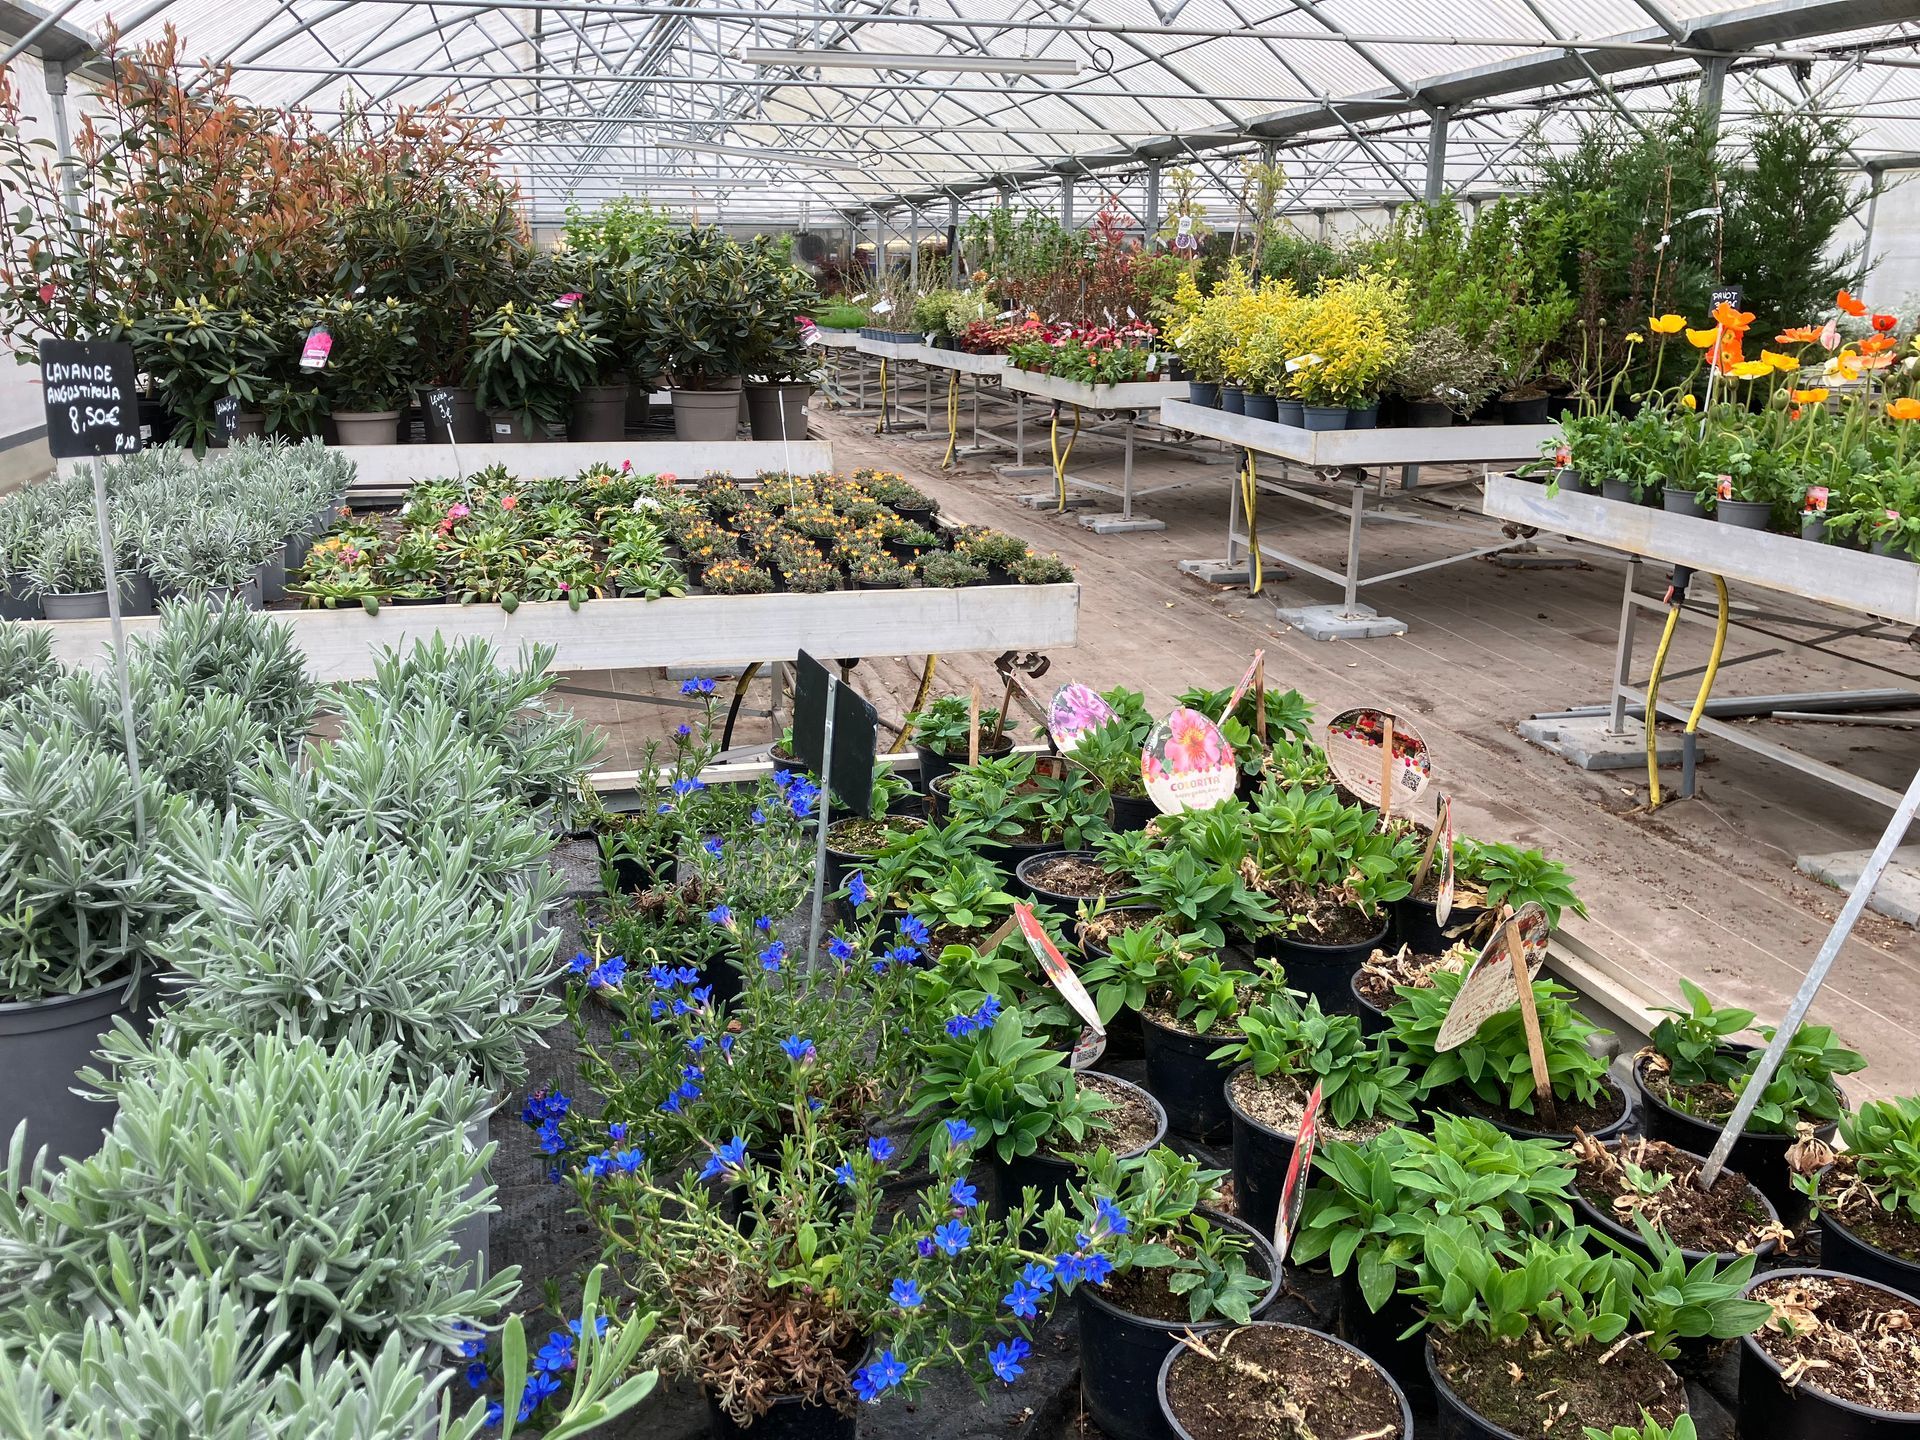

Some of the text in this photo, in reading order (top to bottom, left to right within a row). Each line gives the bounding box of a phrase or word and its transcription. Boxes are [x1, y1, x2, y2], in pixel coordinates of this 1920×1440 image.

[1712, 292, 1738, 301] PAVOT
[46, 362, 113, 383] LAVANDE
[69, 406, 120, 434] 8,50€
[1170, 775, 1221, 791] COLORITA
